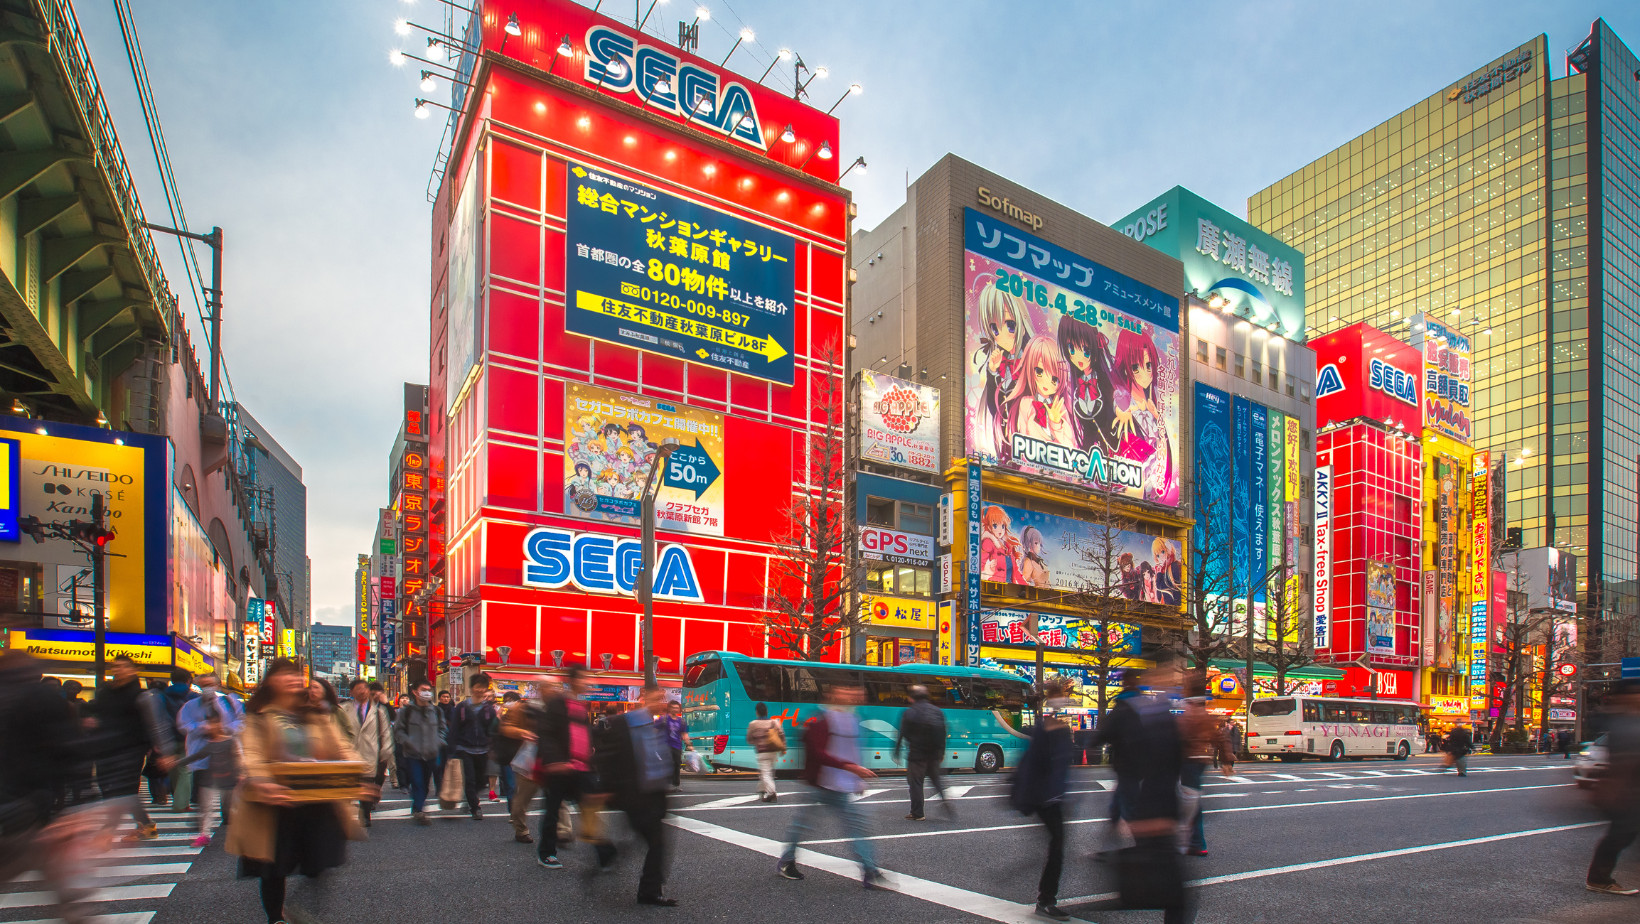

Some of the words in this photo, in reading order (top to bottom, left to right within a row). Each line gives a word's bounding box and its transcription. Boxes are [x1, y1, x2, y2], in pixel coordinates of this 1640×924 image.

[584, 25, 767, 151] SEGA
[977, 186, 1043, 231] Sofmap
[577, 184, 788, 263] 総合マンションギャラリー
[646, 229, 731, 271] 秋葉原館
[1196, 218, 1293, 297] 廣瀬無線
[976, 220, 1094, 287] ソフマップ
[1103, 280, 1172, 318] アミューズメント館
[640, 287, 751, 328] 0120-009-897
[601, 298, 767, 351] 住友不動産秋葉原ビル8F
[1100, 309, 1115, 324] ON
[1118, 316, 1142, 335] SALE
[711, 352, 750, 369] 住友不動産
[1369, 357, 1418, 407] SEGA
[1427, 369, 1470, 404] 高額買取
[575, 397, 719, 437] セガコラボカフェ開催中!!
[873, 401, 889, 415] BIG
[890, 401, 930, 418] APPLE
[867, 428, 884, 441] BIG
[669, 451, 706, 465] ここから
[33, 465, 134, 485] SHISEIDO
[669, 462, 708, 484] 50m
[77, 487, 125, 501] KOSÉ
[1317, 470, 1328, 507] AKKY
[46, 501, 122, 519] Kanbo
[656, 509, 701, 525] 秋葉原新館
[701, 515, 718, 527] 7階
[665, 501, 710, 516] クラブセガ
[862, 529, 908, 554] GPS
[909, 548, 929, 557] next
[1316, 520, 1329, 577] Tax-free
[405, 473, 423, 656] 東京ラジオデパート
[522, 526, 705, 603] SEGA
[890, 556, 929, 567] 0120-915-047
[1315, 579, 1328, 613] Shop
[1425, 573, 1434, 595] GAME
[360, 614, 368, 633] SLOT
[894, 606, 922, 622] 松屋
[969, 587, 979, 642] サポートも
[264, 621, 273, 643] KFC
[27, 645, 96, 656] Matsumot
[105, 649, 152, 660] KiYoshi
[940, 641, 949, 666] 松屋
[1383, 672, 1397, 694] SEGA
[1320, 724, 1390, 738] YUNAGI
